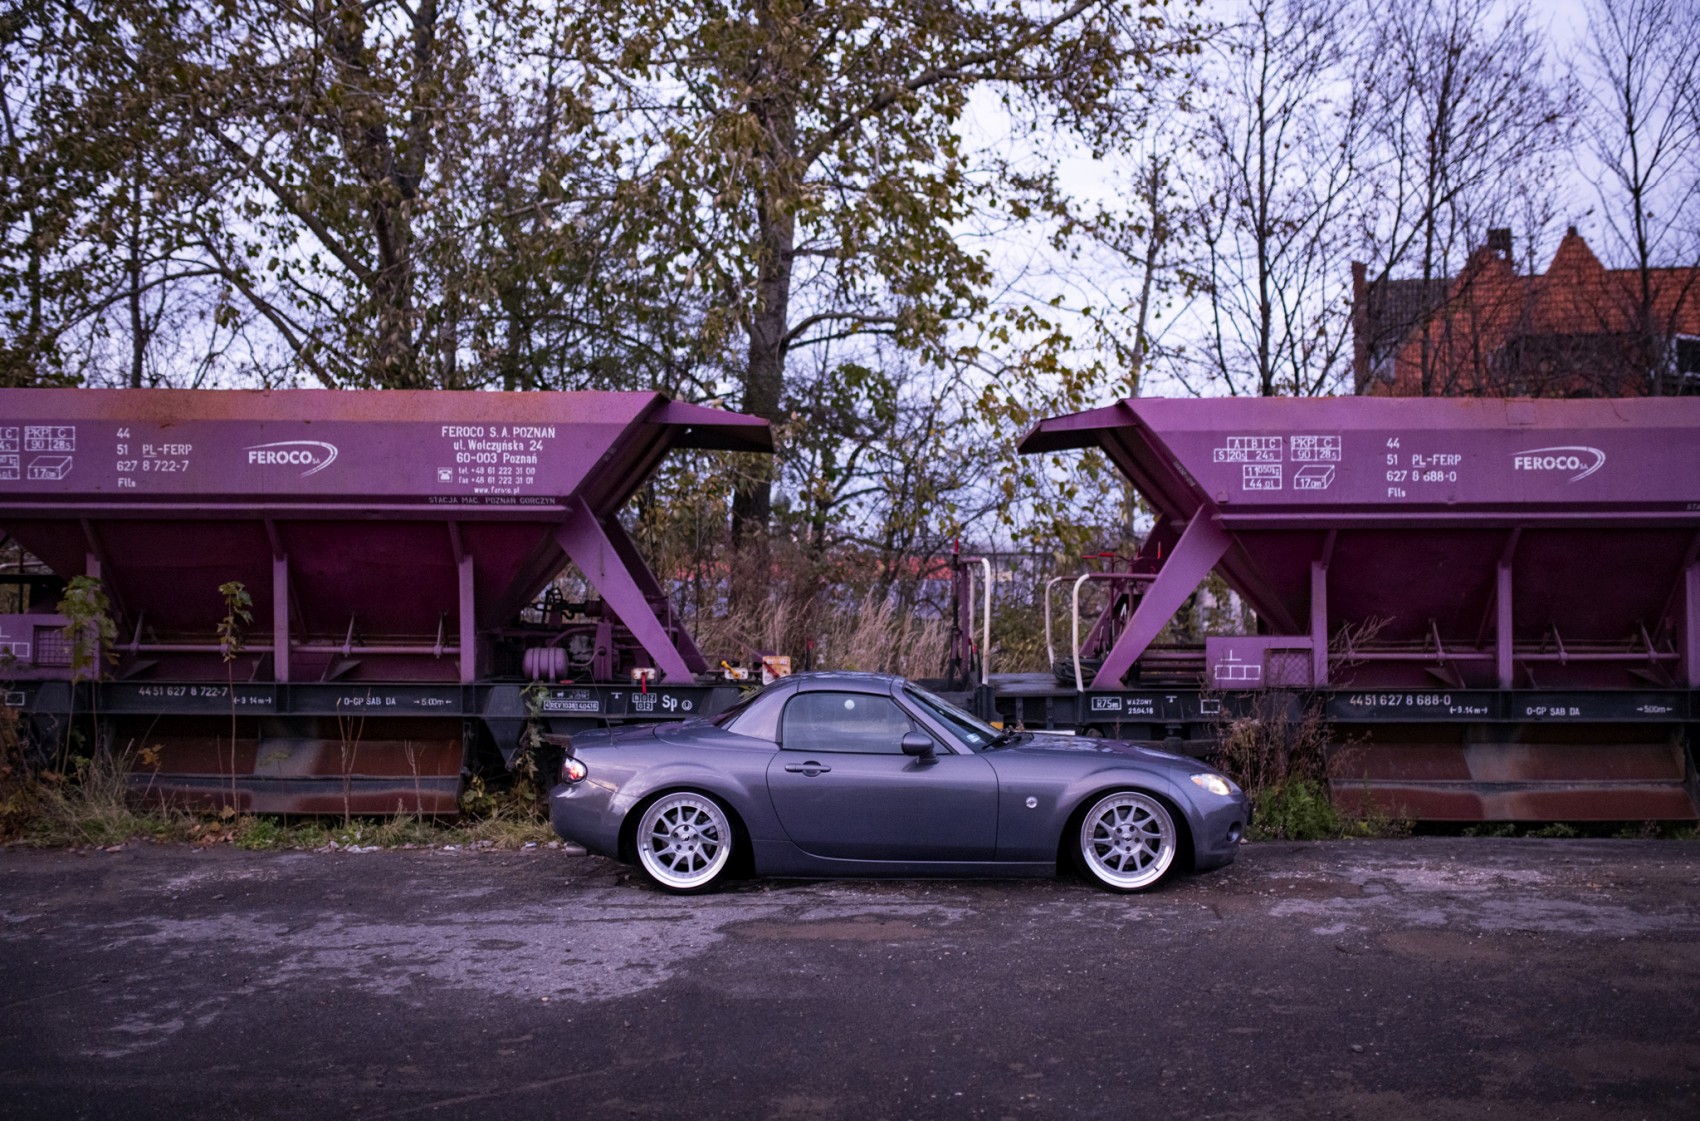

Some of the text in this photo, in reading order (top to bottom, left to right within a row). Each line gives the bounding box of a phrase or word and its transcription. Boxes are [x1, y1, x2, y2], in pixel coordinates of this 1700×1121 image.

[27, 428, 67, 438] PKP C
[116, 427, 130, 438] 44
[442, 426, 484, 438] FEROCO
[512, 425, 556, 439] POZNAŃ
[454, 440, 466, 450] ul.
[530, 440, 544, 452] 24
[1234, 440, 1276, 449] A B C
[1294, 438, 1332, 448] PKP C
[1386, 437, 1400, 448] 44
[116, 444, 192, 456] 51 PL-FERP
[1218, 451, 1225, 460] S
[248, 450, 313, 464] FEROCO
[456, 452, 538, 464] 60-003 Poznań
[1386, 454, 1462, 466] 51 PL-FERP
[116, 460, 190, 472] 627 8 722-7
[1514, 456, 1580, 470] FEROCO
[498, 477, 512, 485] 222
[516, 477, 523, 485] 31
[1386, 470, 1456, 482] 627 8 688-0
[166, 687, 186, 696] 627
[190, 687, 197, 696] 8
[200, 687, 228, 696] 722-7
[366, 697, 381, 706] SAB
[386, 698, 396, 706] DA
[662, 695, 678, 712] Sp
[1380, 694, 1402, 705] 627
[1406, 694, 1413, 705] 8
[1416, 694, 1451, 705] 688-0
[1550, 708, 1566, 716] SAB
[1570, 708, 1580, 716] DA
